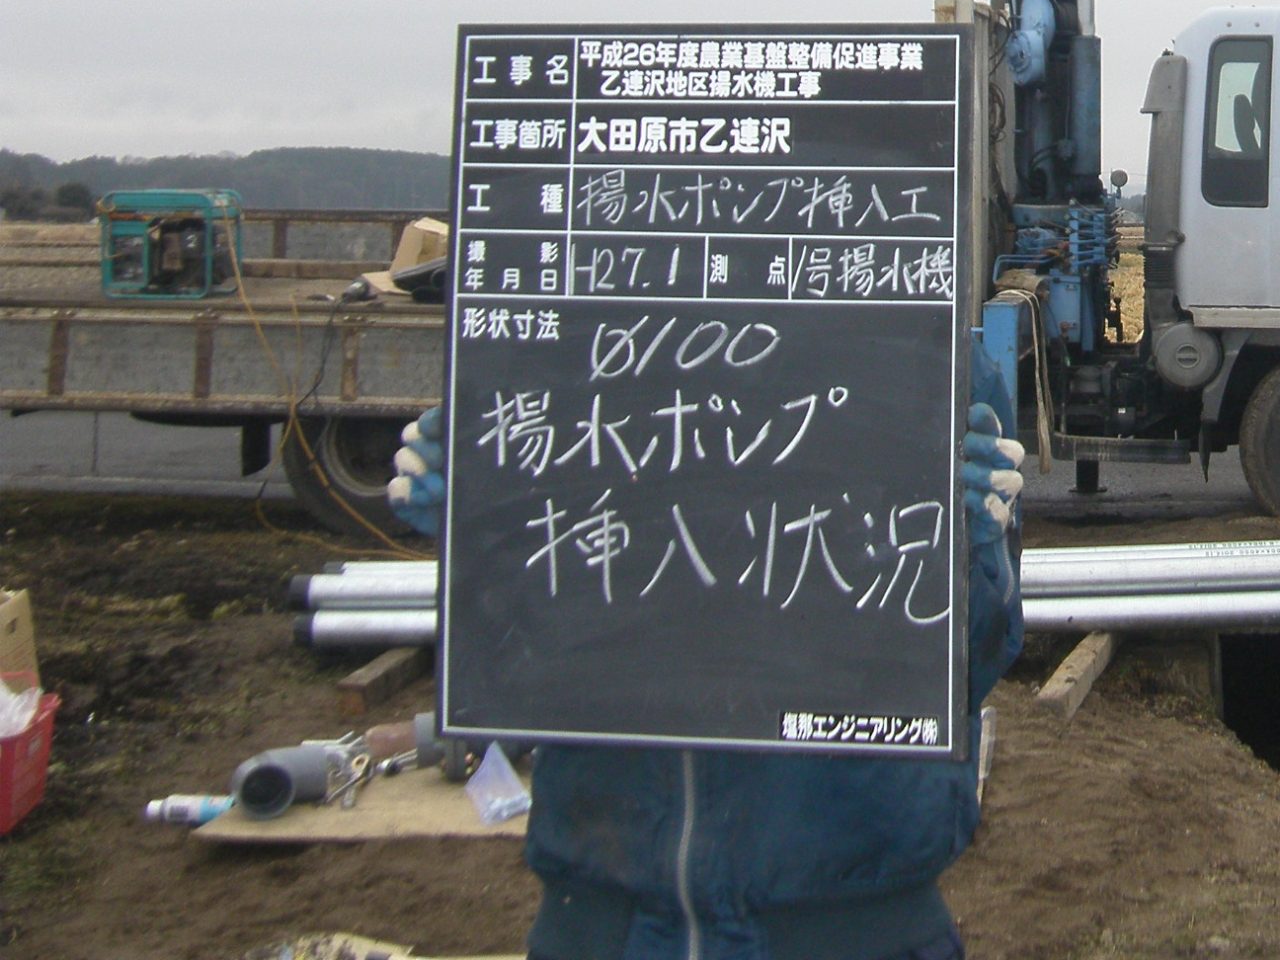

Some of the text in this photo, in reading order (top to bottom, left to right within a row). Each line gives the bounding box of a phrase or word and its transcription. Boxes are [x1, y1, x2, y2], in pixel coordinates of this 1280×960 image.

[474, 54, 569, 85] 工事名
[580, 41, 923, 71] 平成26年度農業基盤整備促進事業
[600, 70, 821, 99] 乙連沢地区揚水機工事
[472, 118, 567, 151] 工事箇所
[578, 117, 791, 154] 大田原市乙連沢
[467, 184, 564, 214] 工種
[465, 266, 556, 291] 年月日
[463, 308, 560, 340] 形状寸法
[477, 387, 848, 477] 揚水ポンプ
[525, 488, 951, 624] 挿入状況
